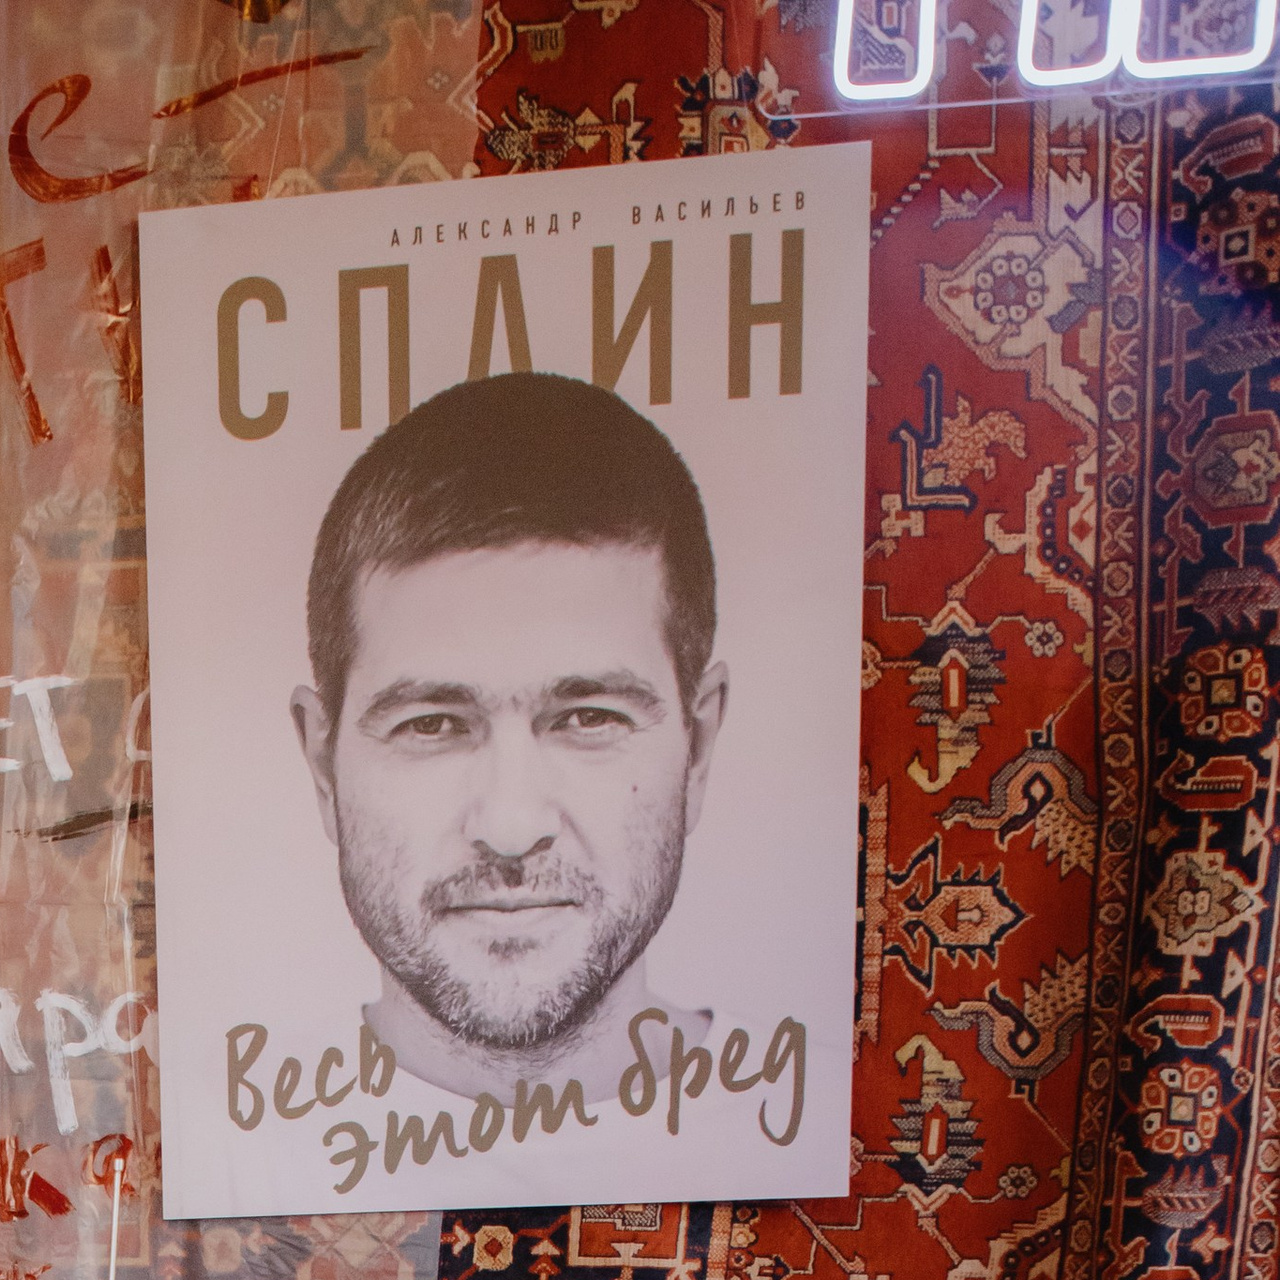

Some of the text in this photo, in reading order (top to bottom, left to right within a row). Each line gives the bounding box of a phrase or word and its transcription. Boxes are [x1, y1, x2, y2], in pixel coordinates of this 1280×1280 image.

[390, 190, 807, 248] АЛЕКСАНДР ВАСИЛЬЕВ
[216, 227, 807, 443] СПЛИН
[226, 997, 807, 1194] Весь этот бред
